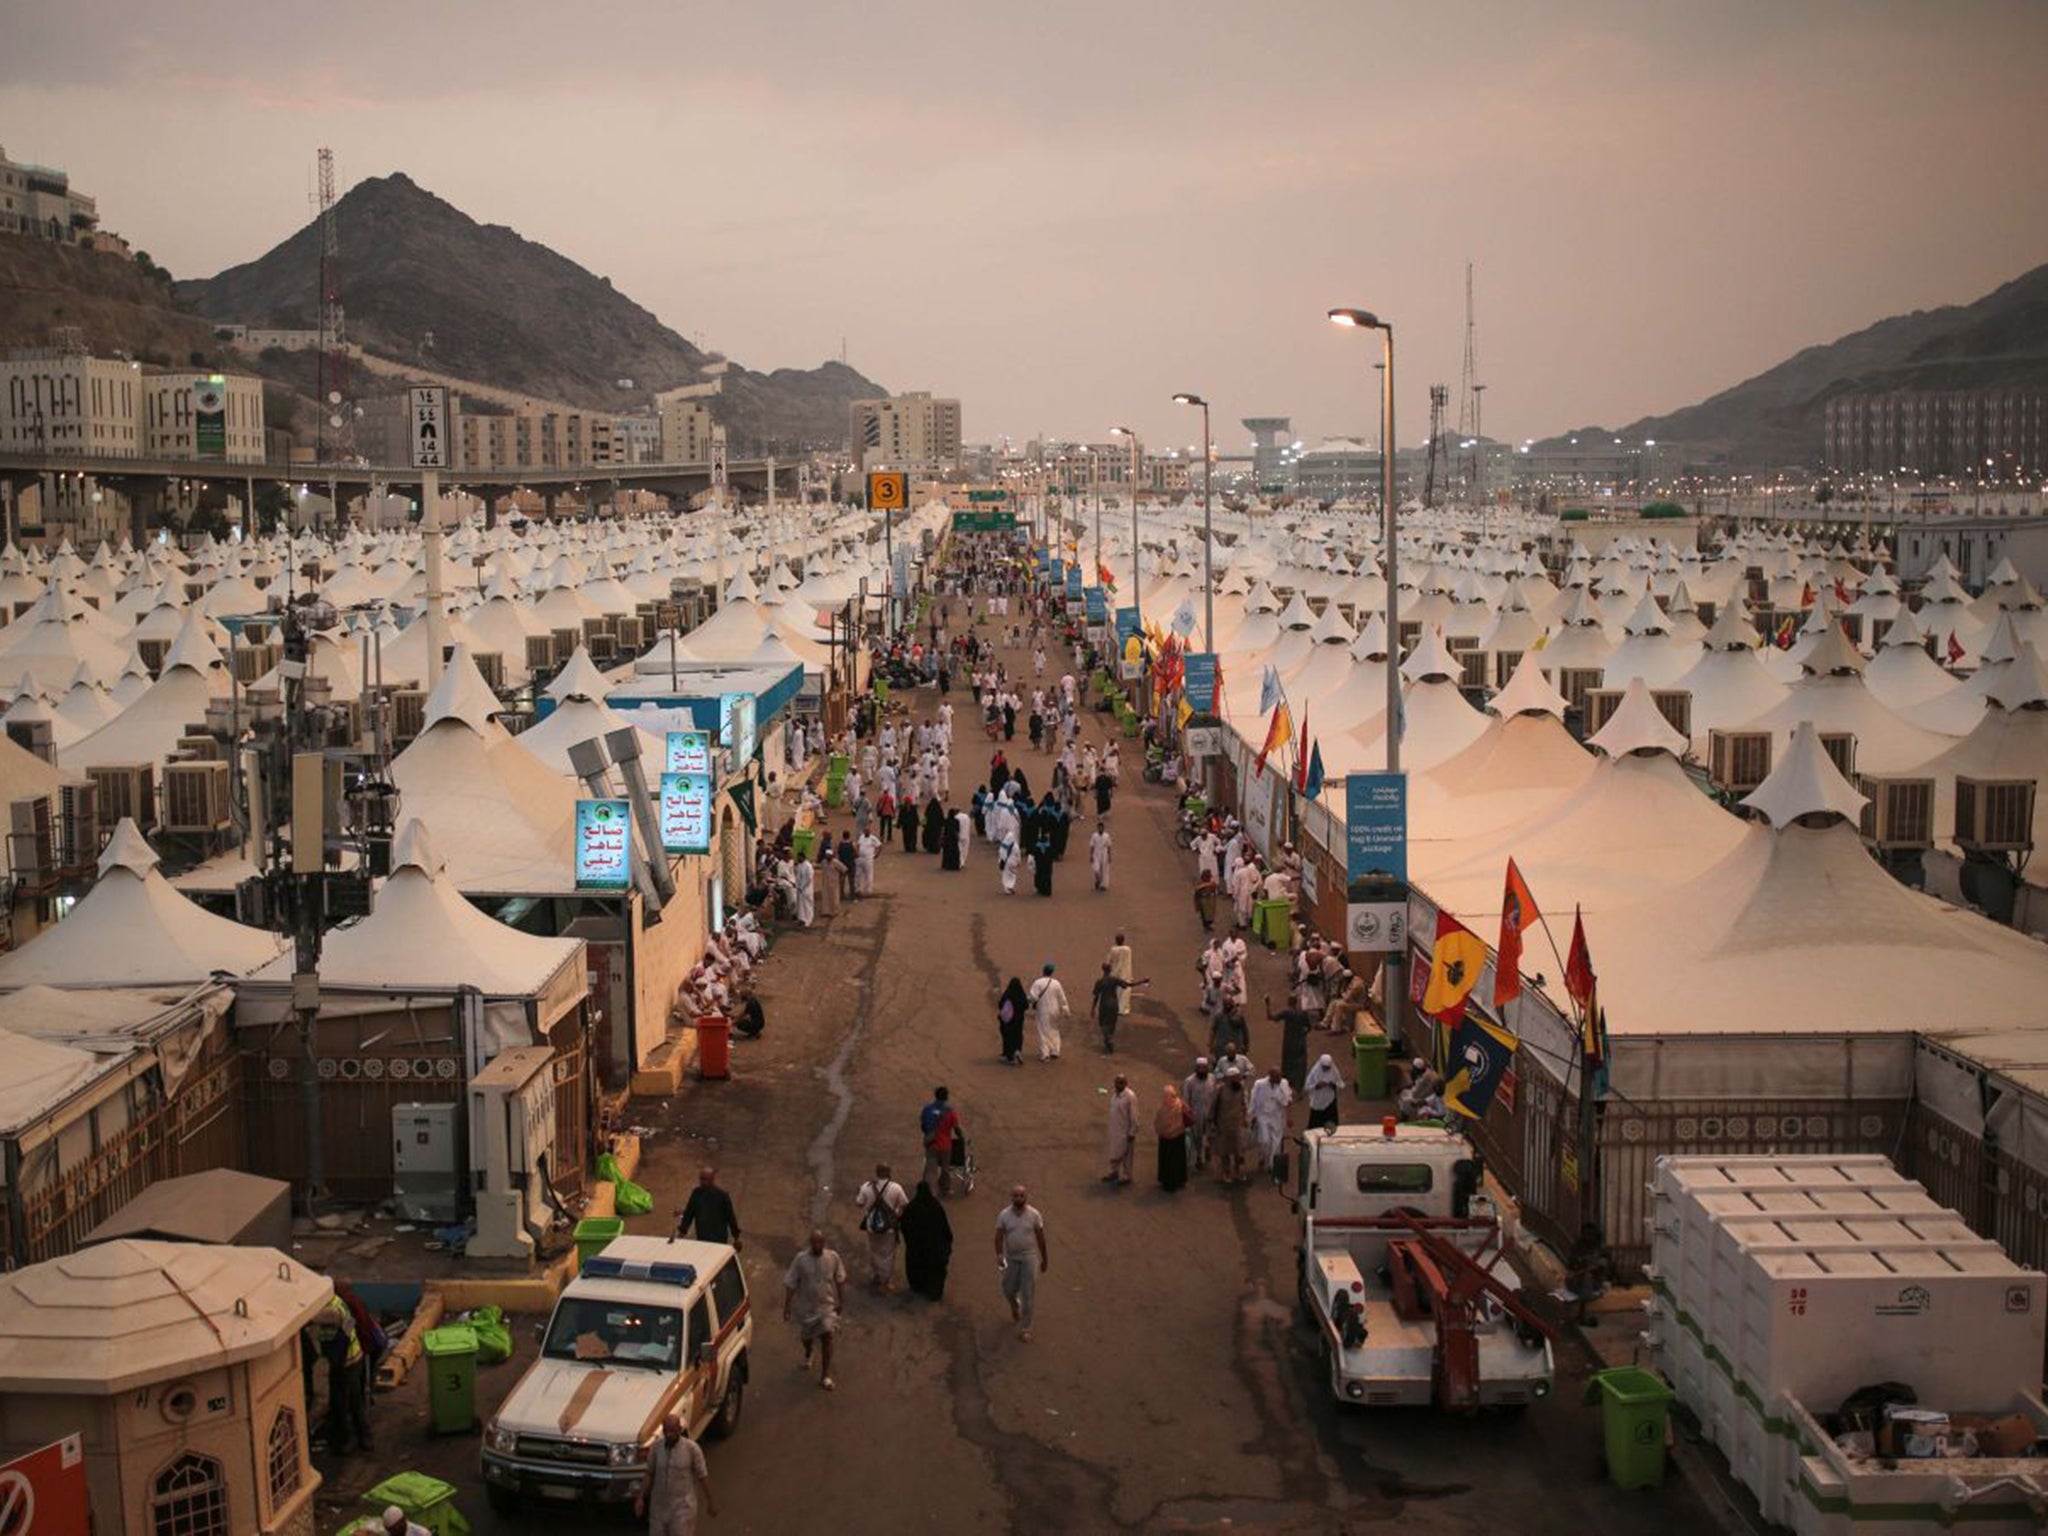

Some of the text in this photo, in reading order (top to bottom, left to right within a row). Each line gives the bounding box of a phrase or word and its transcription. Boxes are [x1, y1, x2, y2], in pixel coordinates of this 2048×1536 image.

[421, 441, 436, 451] 14
[420, 454, 439, 465] 44
[881, 482, 894, 498] 3
[666, 795, 702, 809] صالح
[583, 824, 624, 840] صالح
[585, 839, 623, 853] شاهر
[448, 1374, 461, 1391] 3
